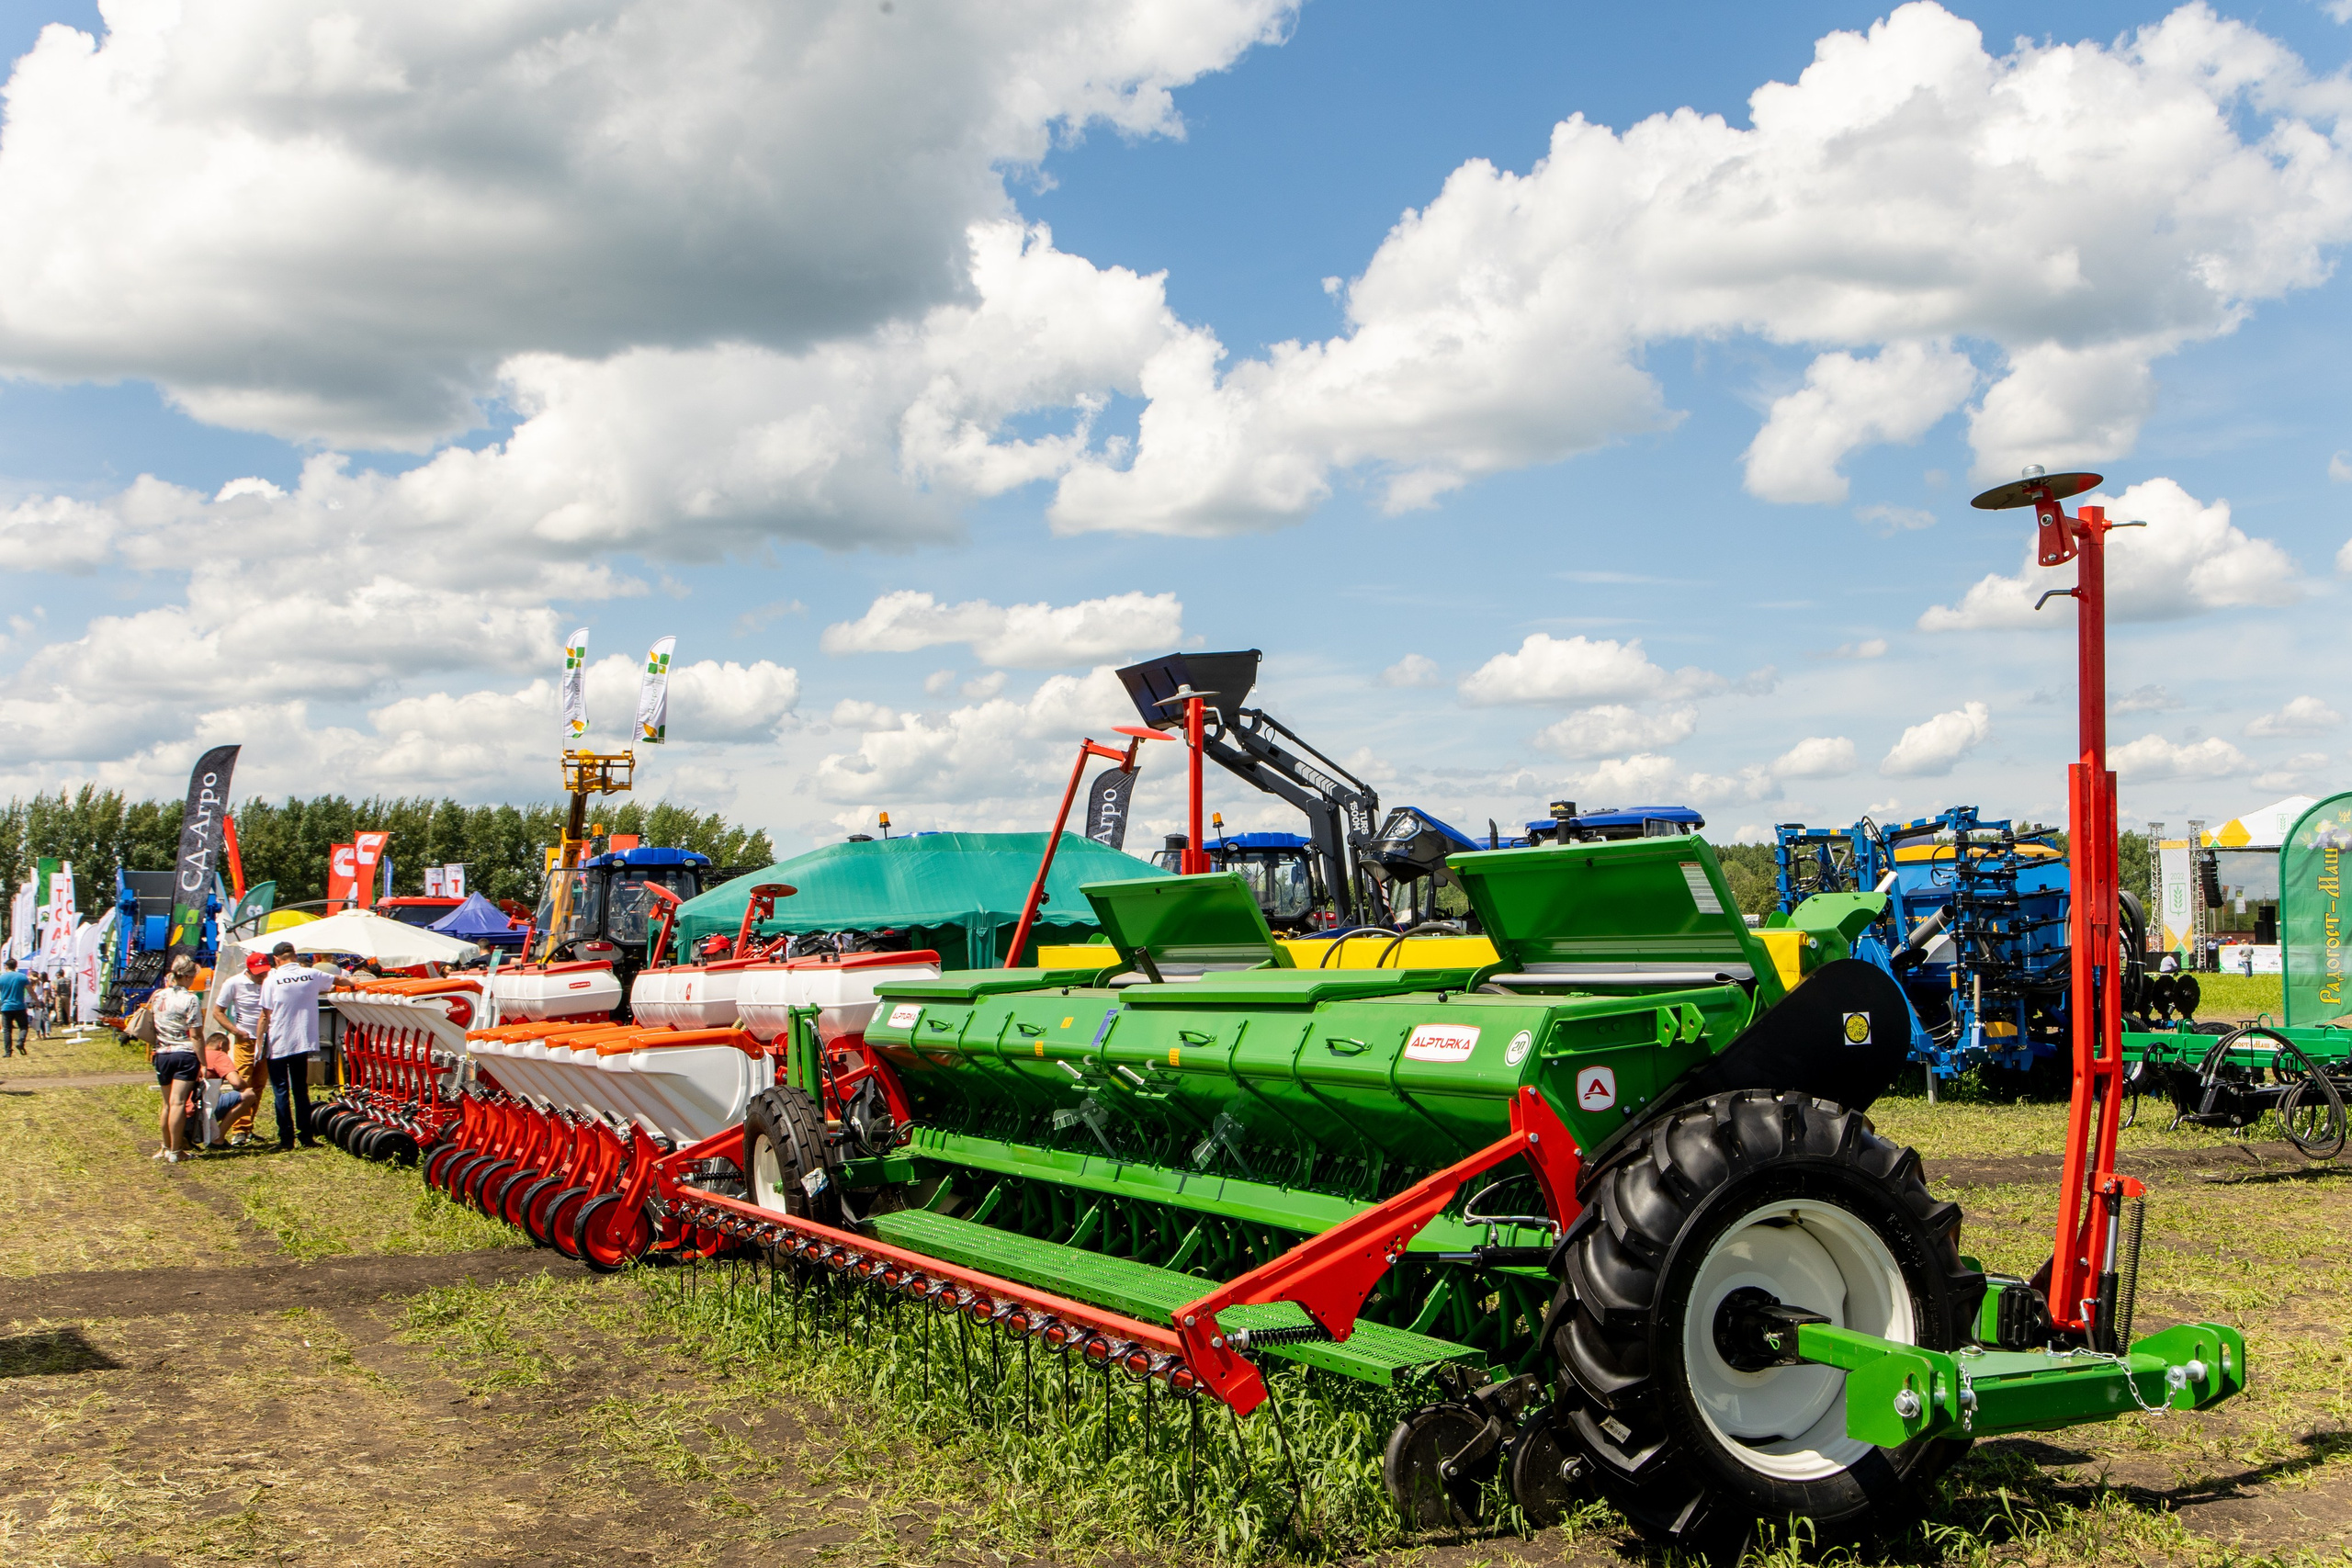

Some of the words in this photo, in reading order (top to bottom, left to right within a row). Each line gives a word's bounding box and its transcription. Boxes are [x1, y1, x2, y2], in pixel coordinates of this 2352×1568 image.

[1093, 788, 1122, 846] Агро
[1350, 800, 1361, 831] 1500M
[1360, 810, 1369, 835] TURS
[181, 772, 220, 892] СД-Агро
[2170, 872, 2185, 880] 2022
[2318, 847, 2345, 1005] Радогост-Маш
[277, 975, 313, 985] LOVOL
[1411, 1036, 1470, 1050] ALPTURKA
